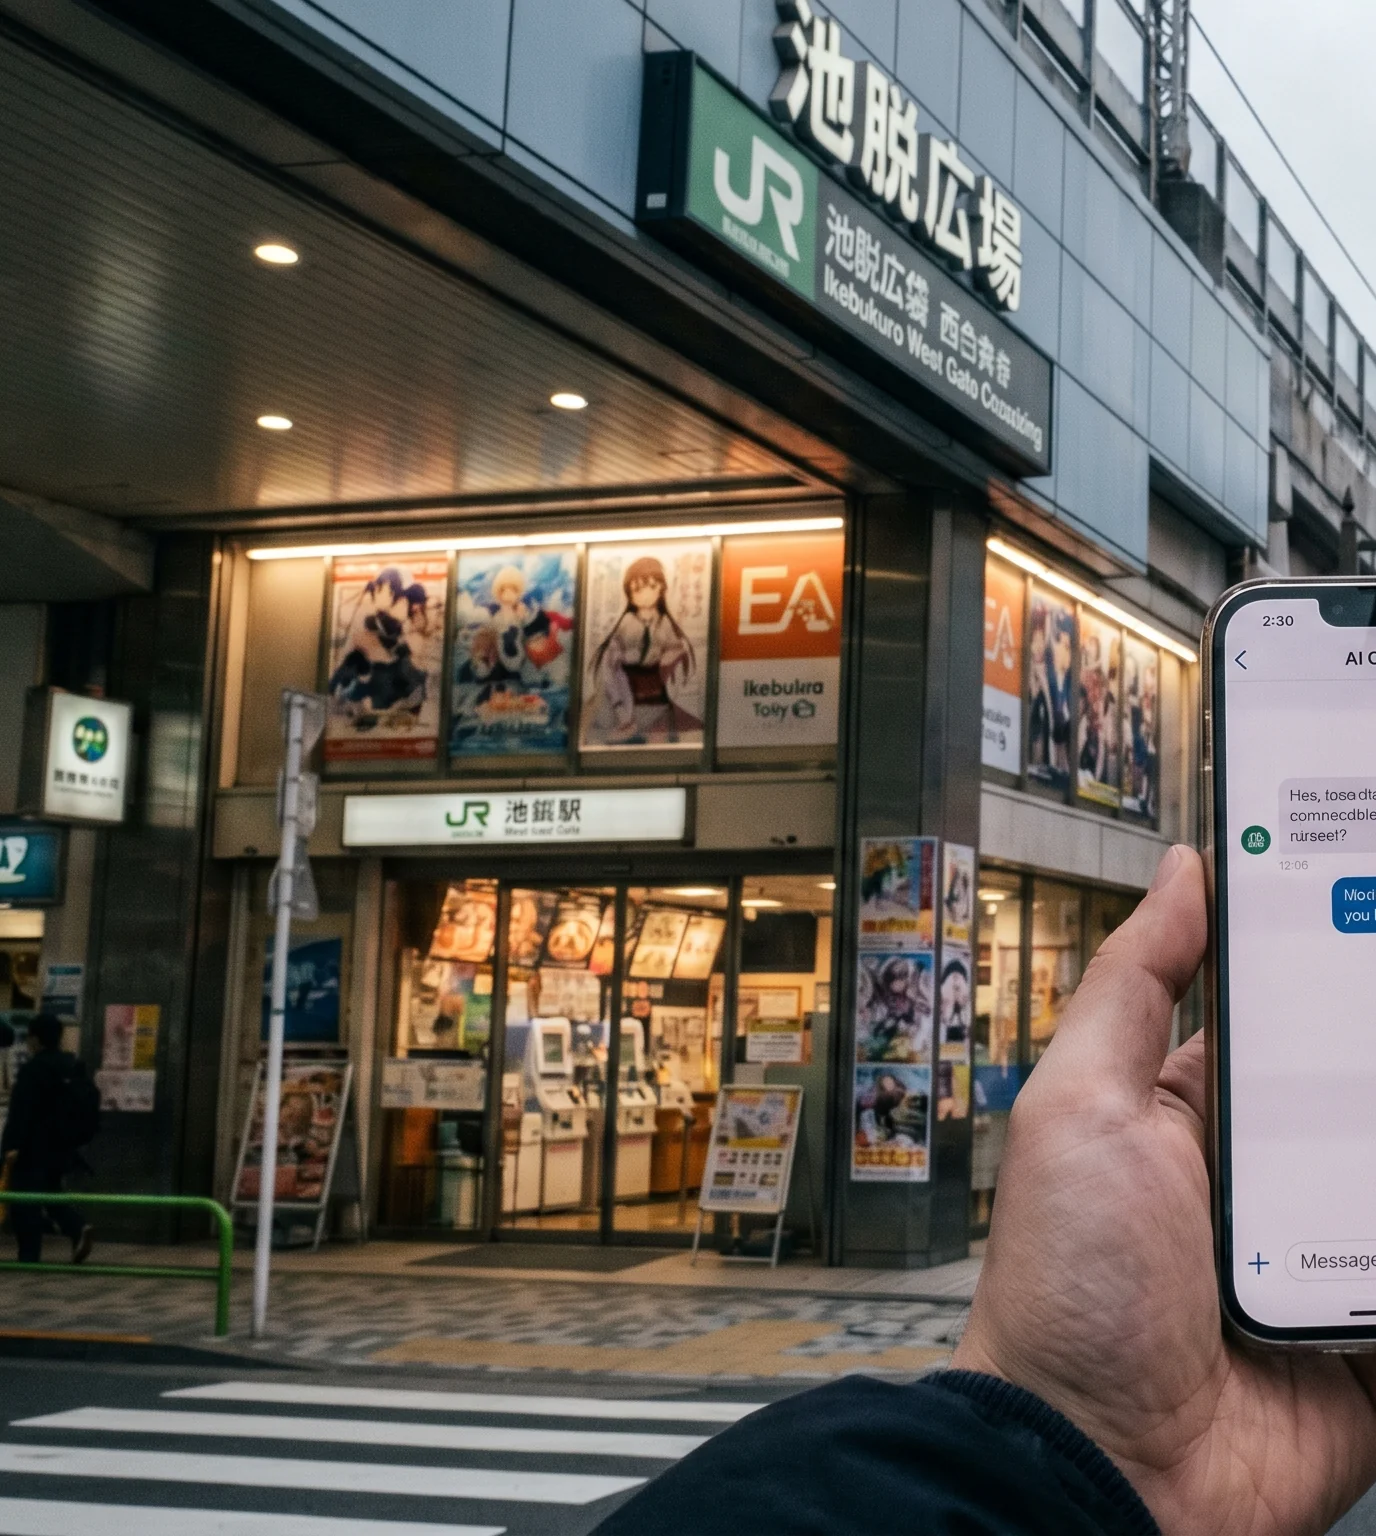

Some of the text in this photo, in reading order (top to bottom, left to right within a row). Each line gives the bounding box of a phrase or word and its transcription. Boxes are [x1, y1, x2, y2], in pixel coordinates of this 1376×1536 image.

[714, 135, 804, 262] JR
[824, 263, 904, 346] Ikebukuro
[907, 324, 943, 376] West
[1262, 615, 1294, 627] 2:30
[1345, 651, 1363, 666] AI
[1290, 789, 1321, 804] Hes,
[445, 801, 490, 827] JR
[1279, 860, 1309, 871] 12:06
[1344, 910, 1370, 925] you
